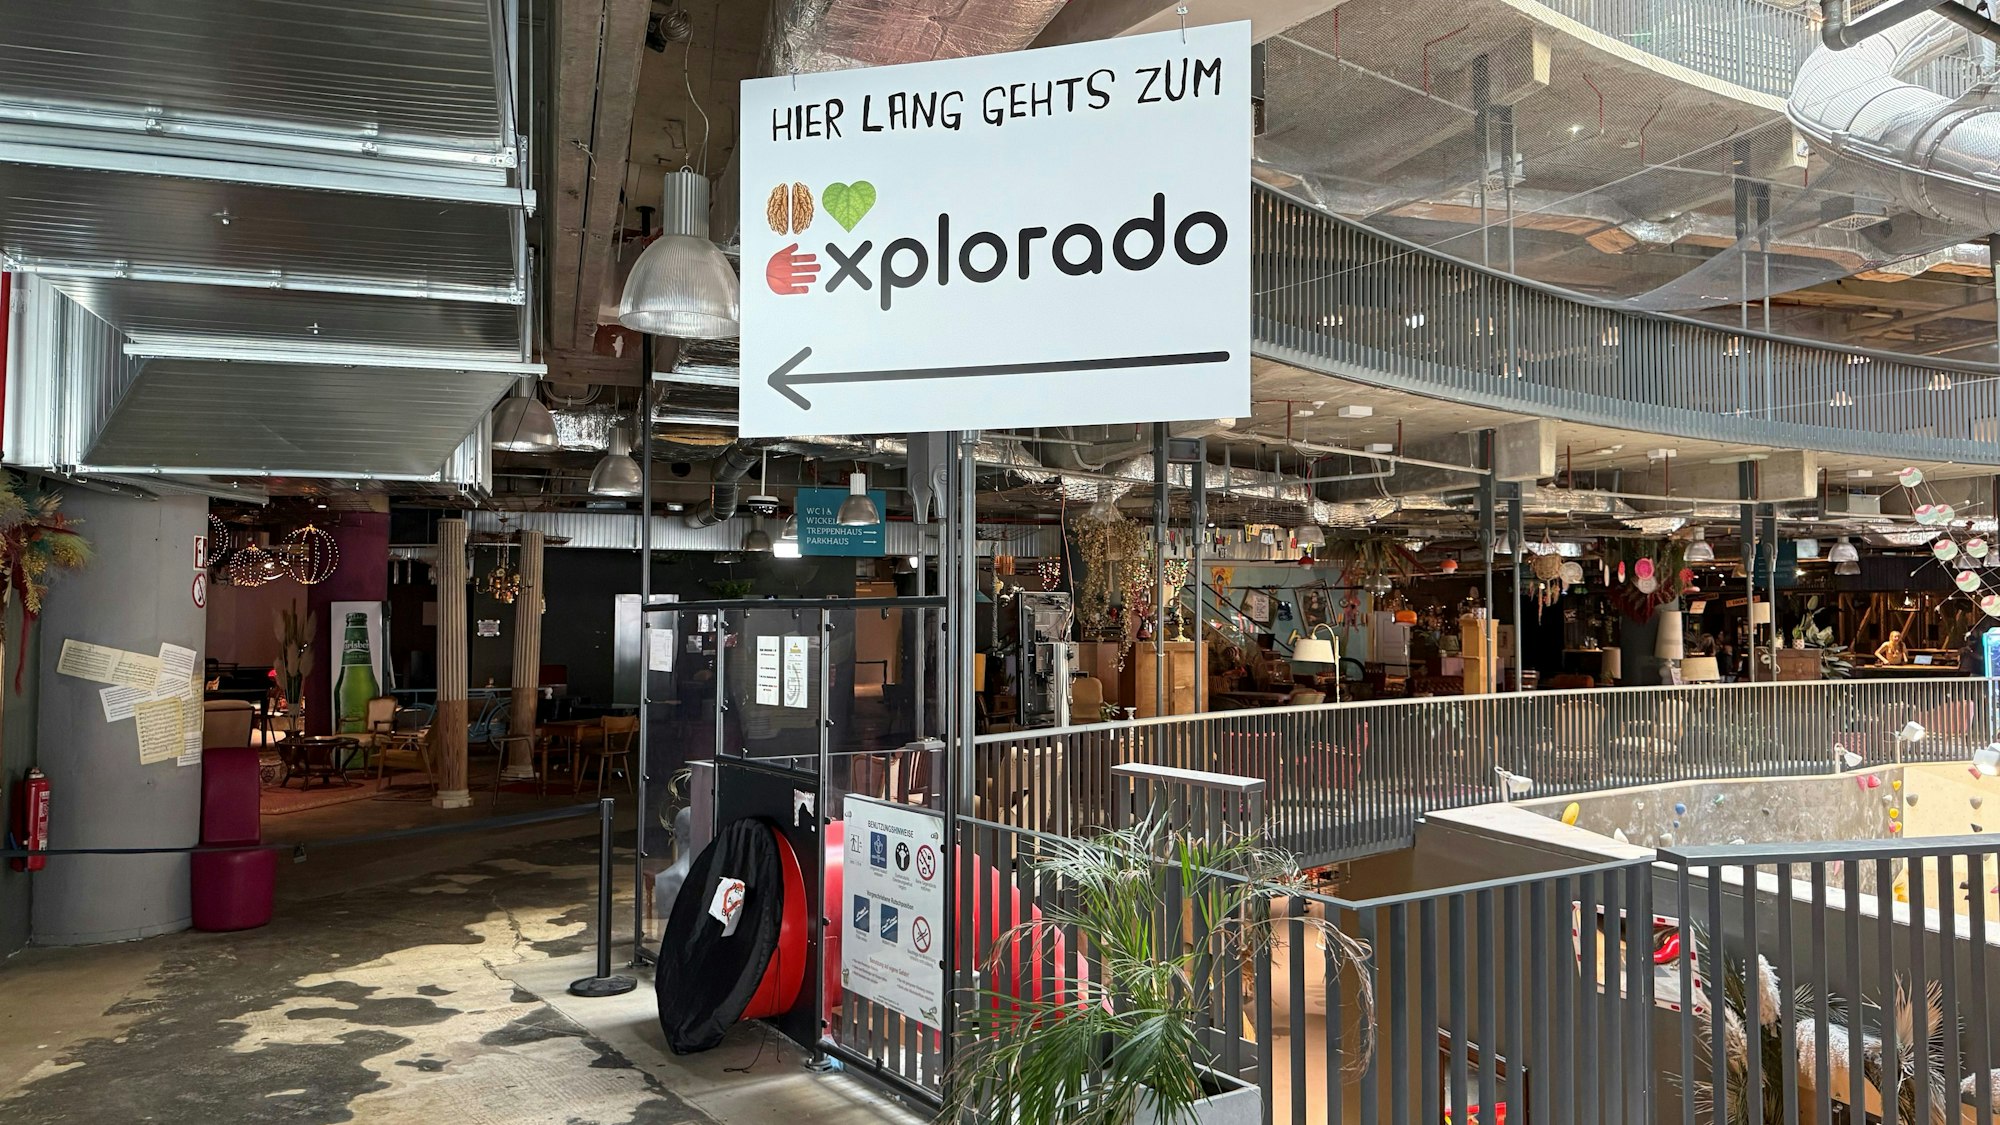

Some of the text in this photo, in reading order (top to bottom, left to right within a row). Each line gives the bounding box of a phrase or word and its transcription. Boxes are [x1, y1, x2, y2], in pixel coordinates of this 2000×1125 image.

[772, 57, 1222, 142] HIER LANG GEHTS ZUM
[806, 507, 820, 515] WC
[806, 527, 863, 536] TREPPENHAUS
[806, 537, 849, 545] PARKHAUS
